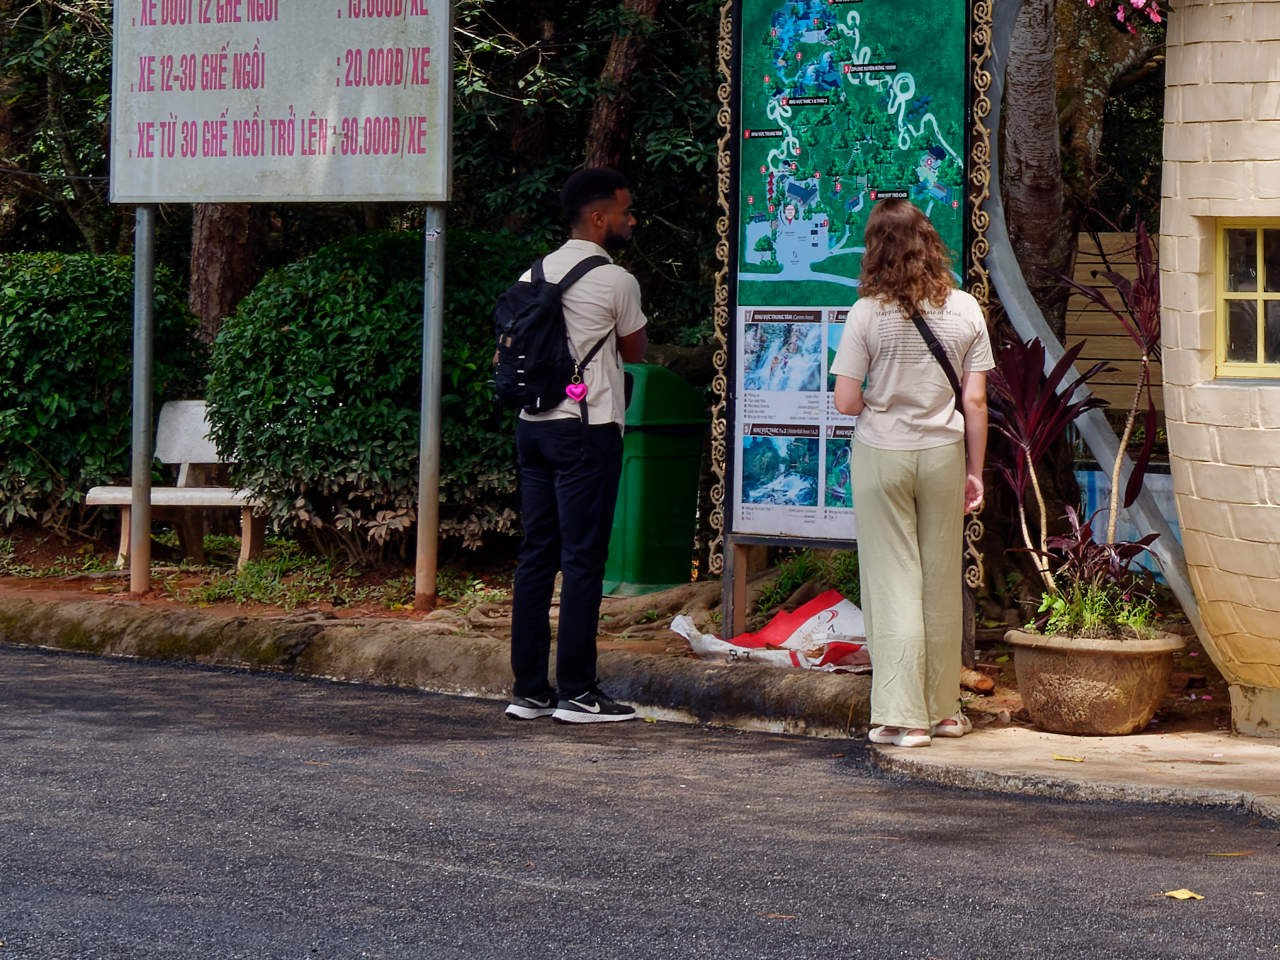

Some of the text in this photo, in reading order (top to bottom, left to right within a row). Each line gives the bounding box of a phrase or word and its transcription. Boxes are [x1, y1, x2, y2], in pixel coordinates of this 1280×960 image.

[138, 55, 156, 93] XE
[160, 53, 197, 91] 12-30
[200, 40, 230, 91] GHẾ
[232, 37, 265, 90] NGỒI
[137, 121, 155, 158] XE
[159, 111, 178, 158] TỪ
[180, 120, 198, 158] 30
[202, 106, 229, 157] GHẾ
[232, 104, 265, 157] NGỒI
[269, 103, 296, 156] TRỞ
[300, 109, 328, 156] LÊN
